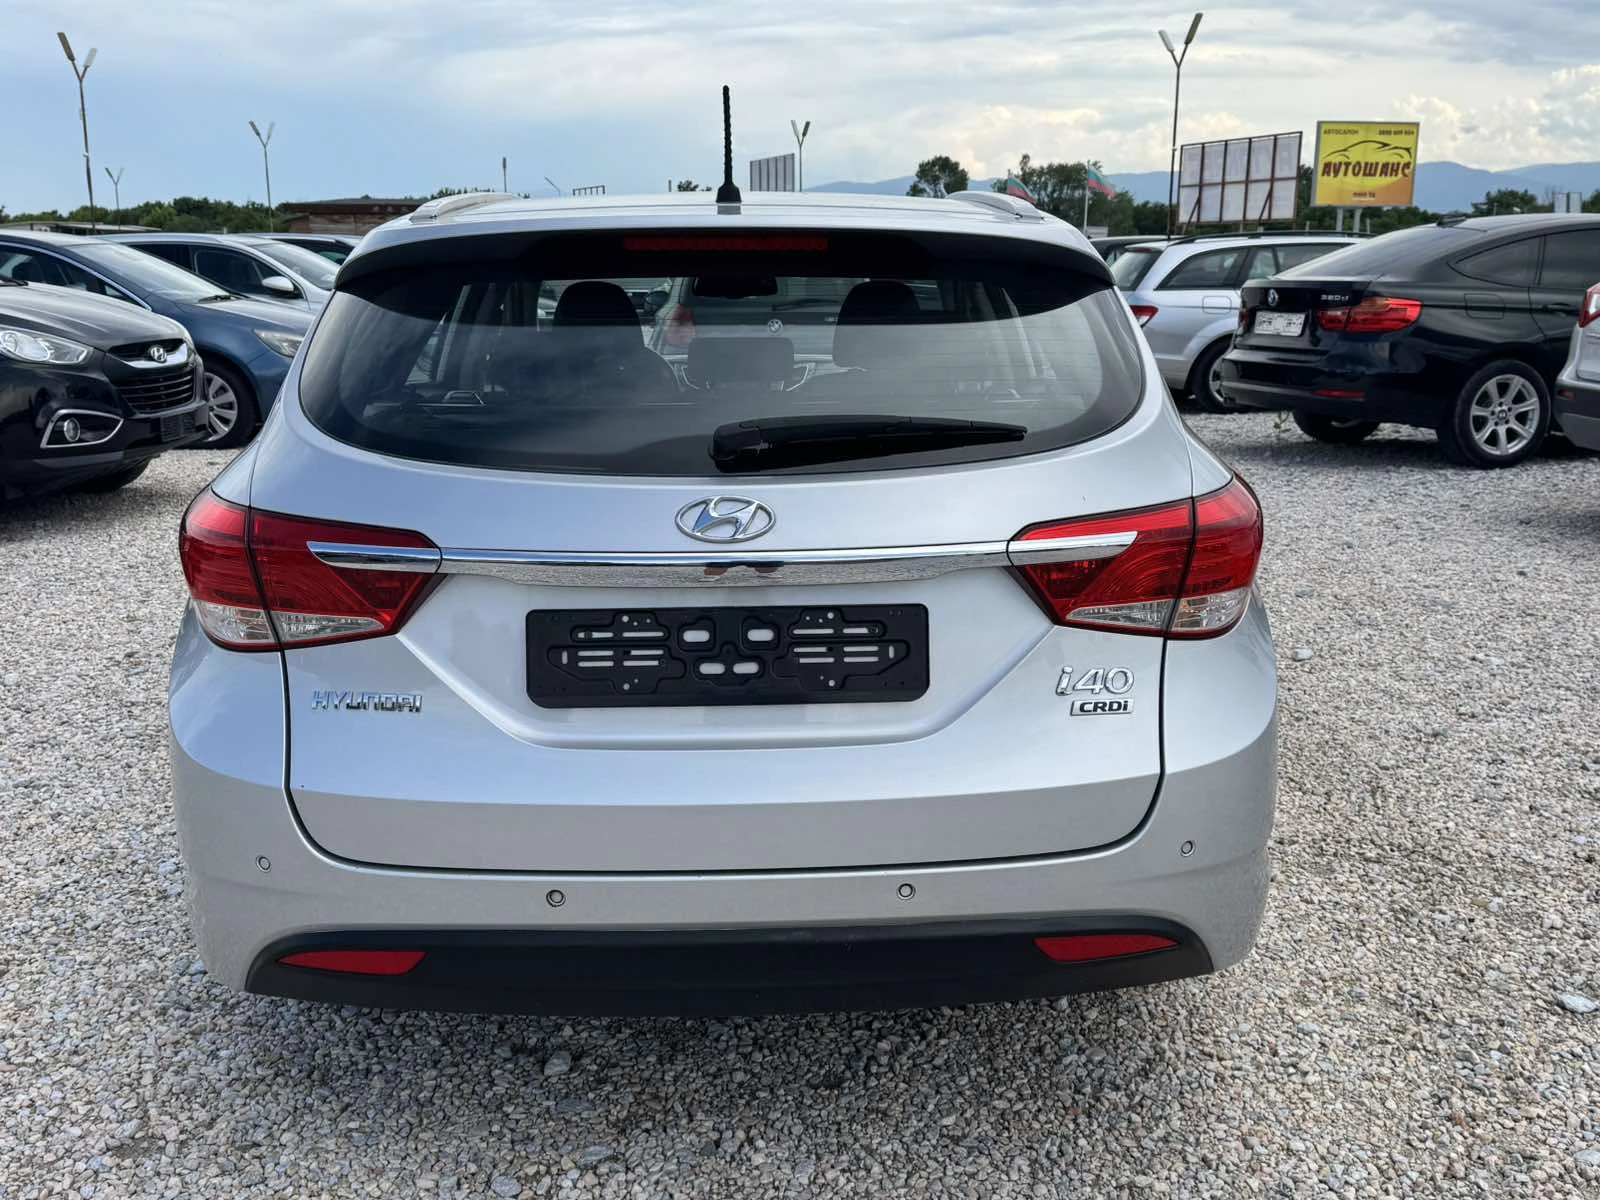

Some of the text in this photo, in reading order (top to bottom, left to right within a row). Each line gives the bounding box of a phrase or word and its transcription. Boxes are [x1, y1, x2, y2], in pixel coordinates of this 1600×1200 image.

[1321, 160, 1411, 178] АУТОШАНС
[1056, 666, 1134, 696] i40
[311, 690, 422, 713] HYUNDAI
[1080, 700, 1129, 713] CRDi
